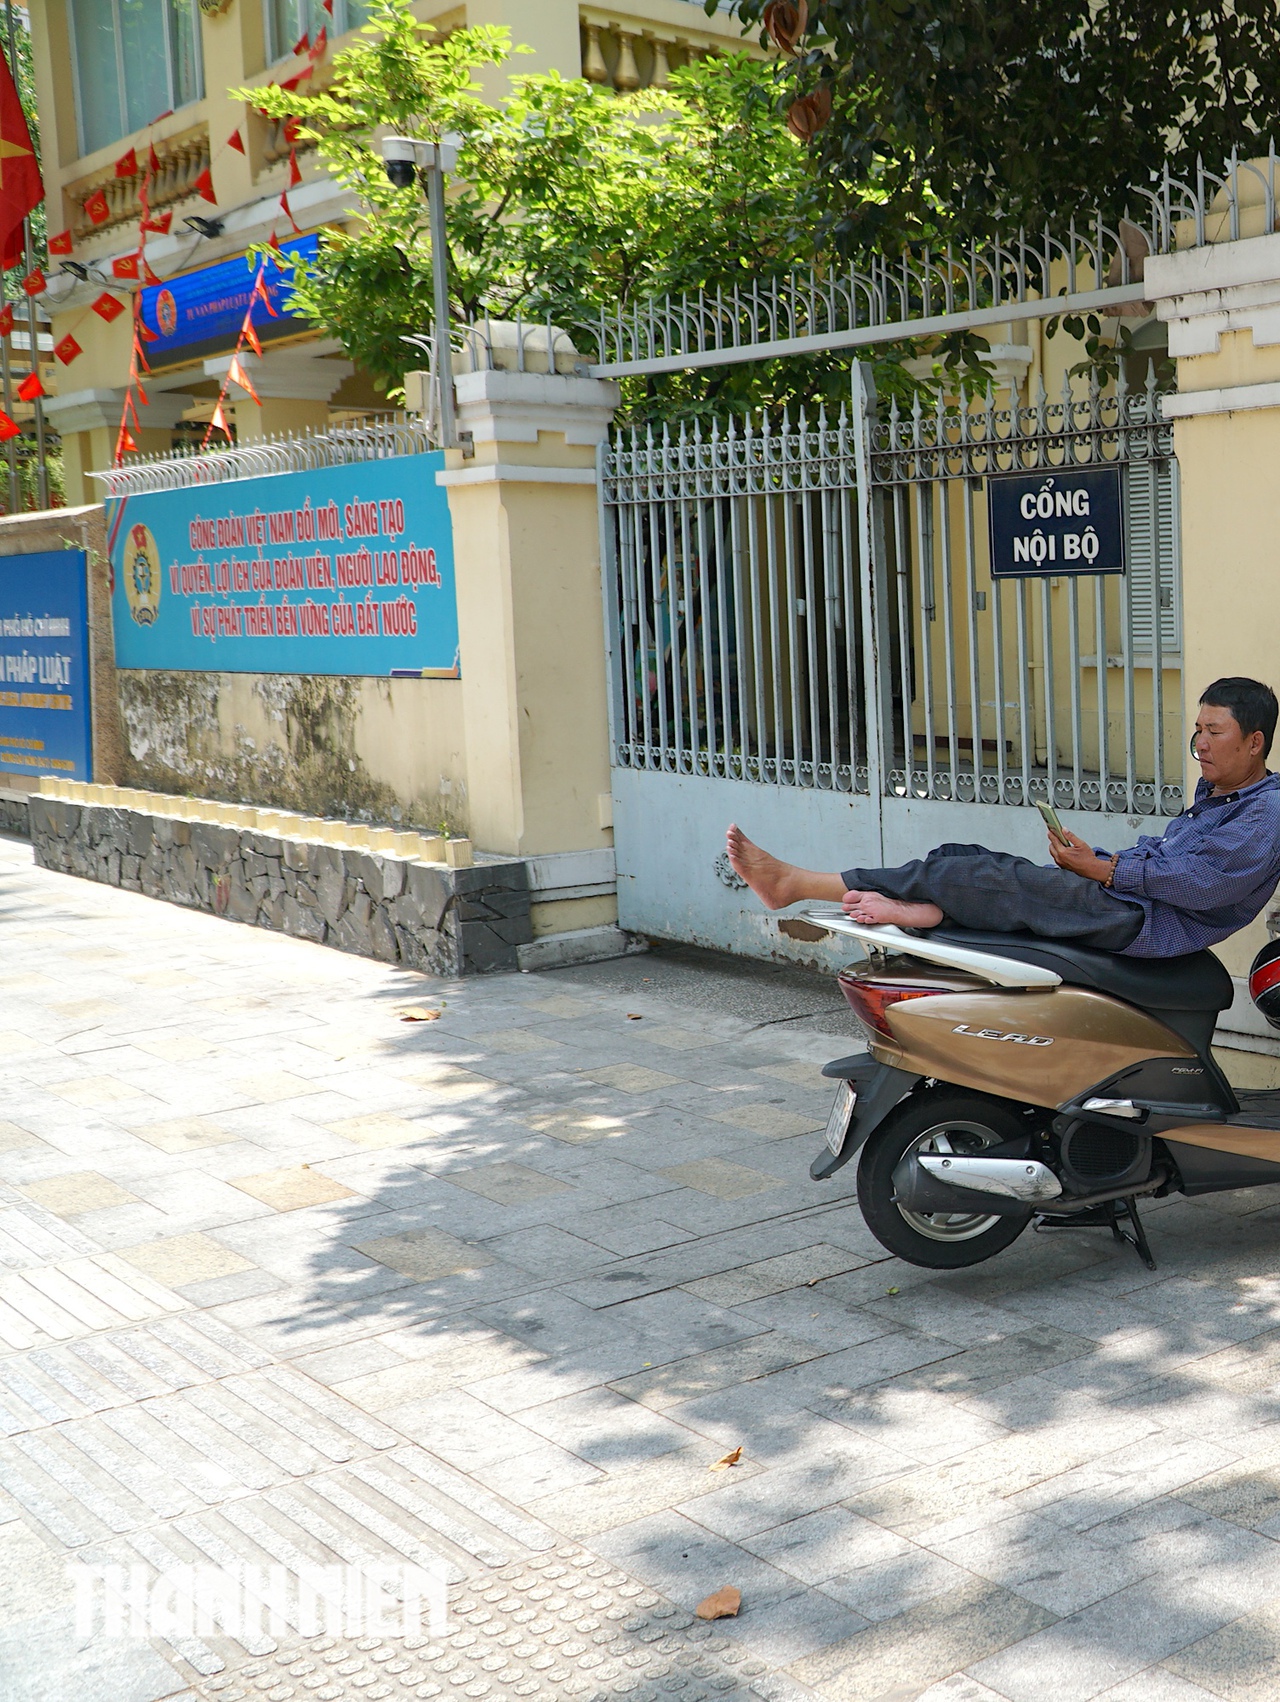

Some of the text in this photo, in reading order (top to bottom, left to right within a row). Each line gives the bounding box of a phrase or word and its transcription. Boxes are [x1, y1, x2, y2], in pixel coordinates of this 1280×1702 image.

[1020, 478, 1090, 520] CỔNG
[190, 495, 404, 560] CÔNG ĐOÀN VIỆT NAM ĐỔI MỚI, SÁNG TẠO
[1013, 525, 1099, 567] NỘI BỘ
[170, 542, 441, 599] VÌ QUYỀN, LỢI ÍCH CỦA ĐOÀN VIÊN, NGƯỜI LAO ĐỘNG,
[190, 600, 201, 636] VÌ
[202, 603, 216, 643] SỰ
[217, 600, 242, 636] PHÁT
[243, 593, 275, 636] TRIỂN
[275, 594, 298, 636] BỀN
[298, 598, 330, 636] VỮNG
[331, 592, 356, 636] CỦA
[356, 590, 380, 636] ĐẤT
[381, 594, 418, 636] NƯỚC
[6, 649, 38, 683] PHÁP
[38, 652, 71, 691] LUẬT
[952, 1024, 1055, 1047] LEAD
